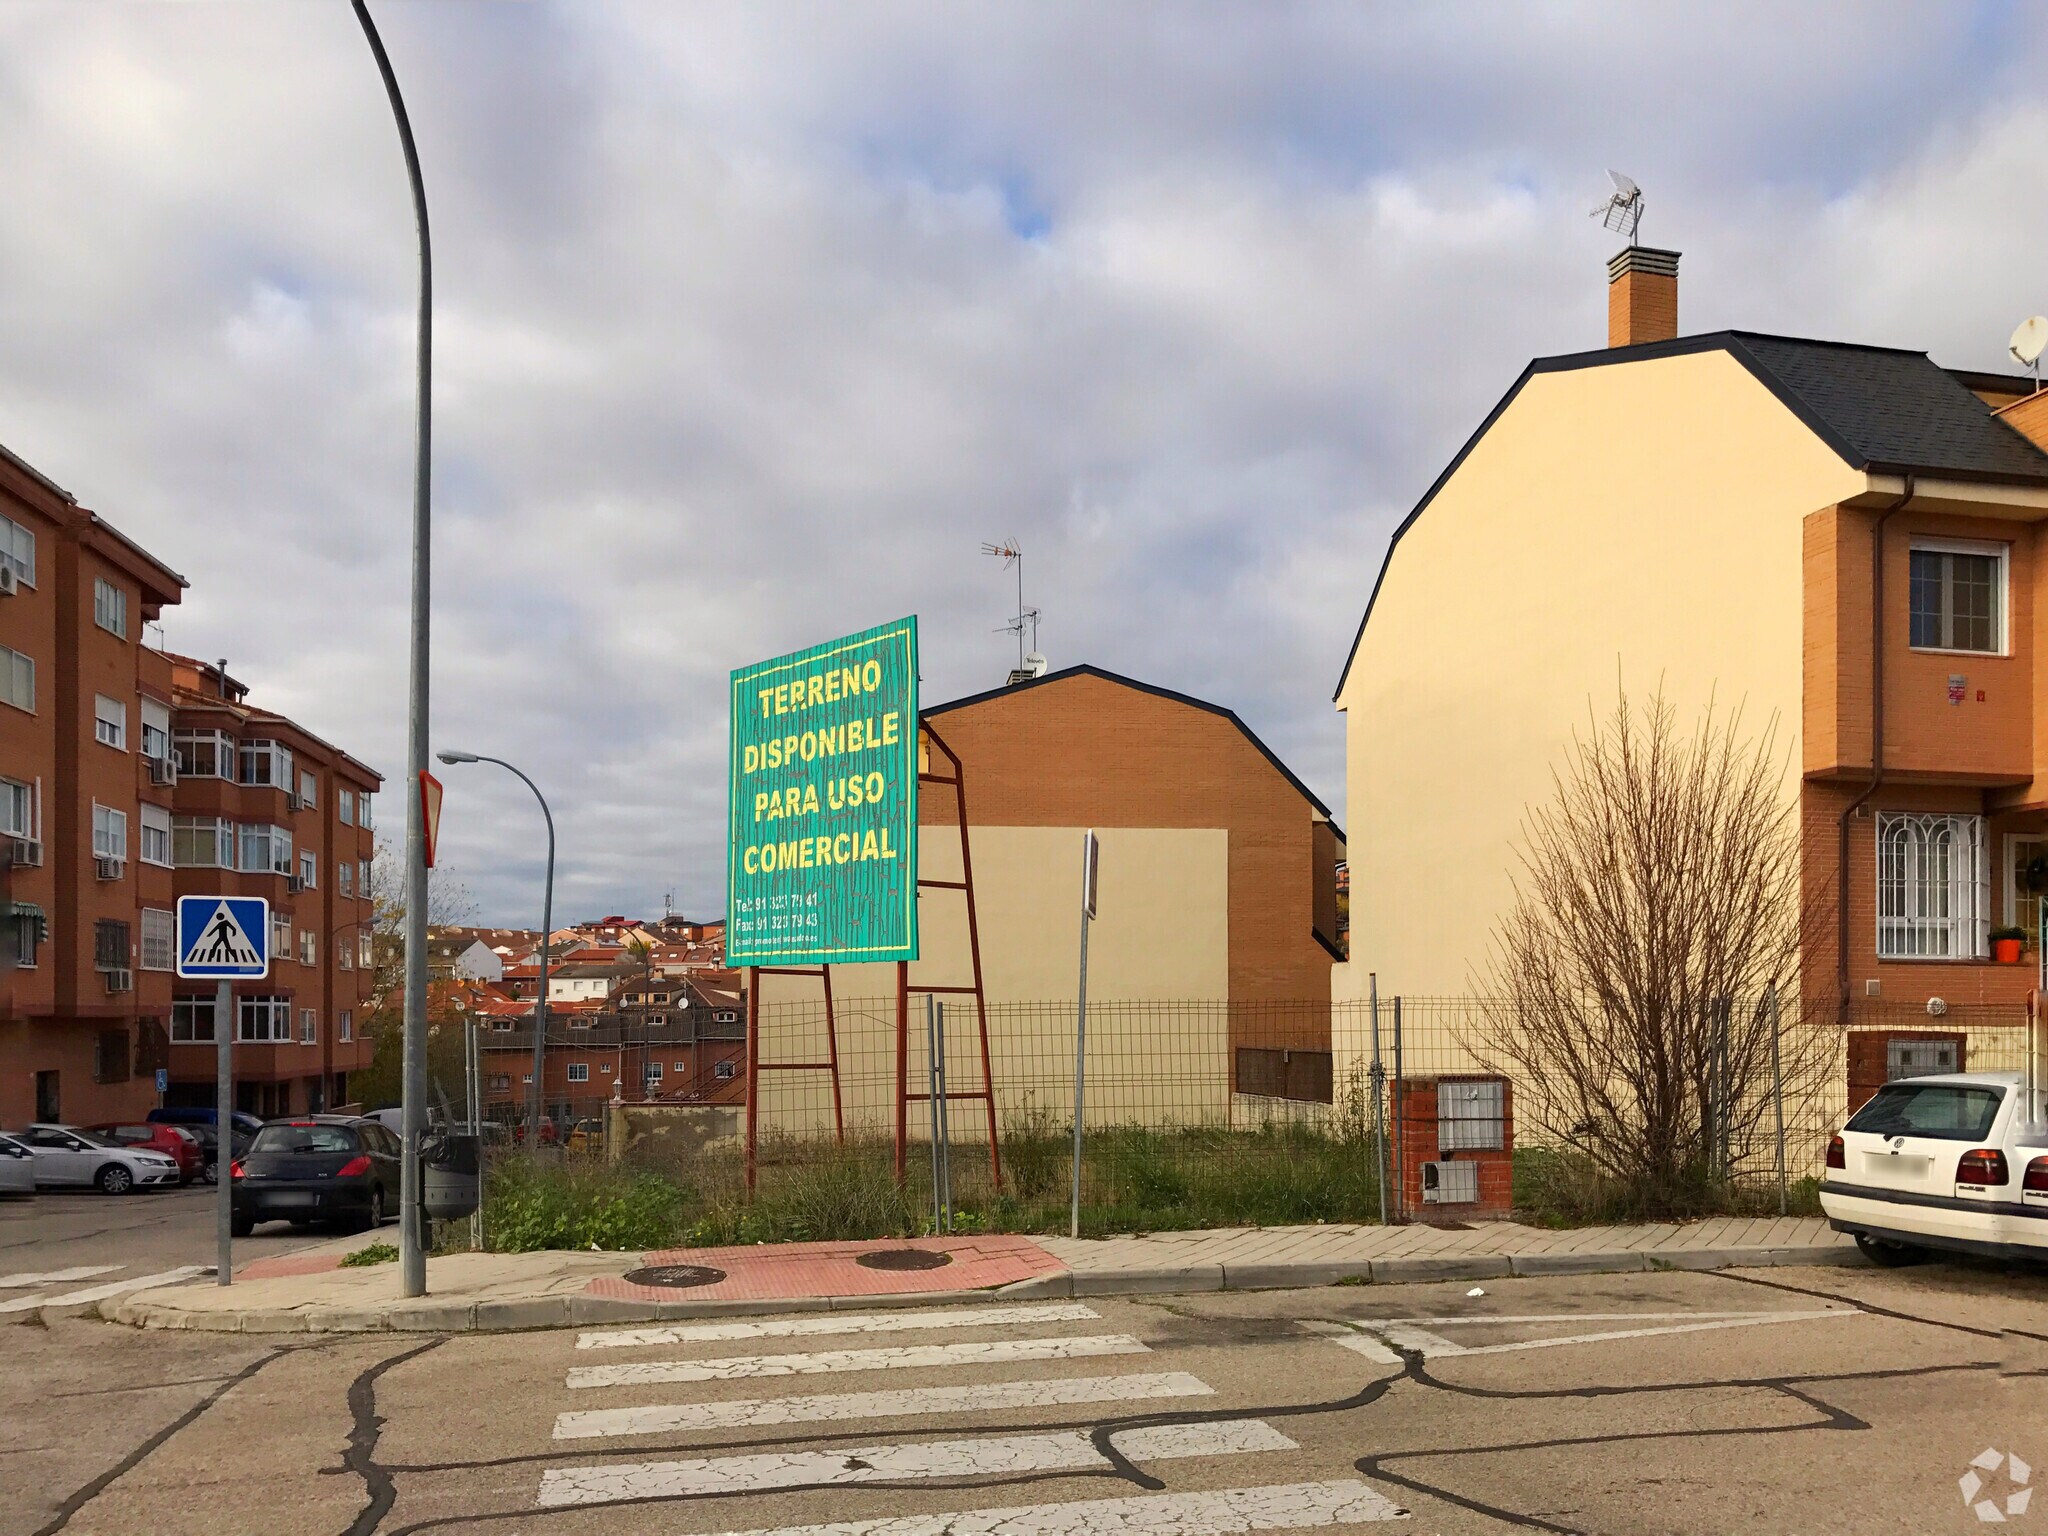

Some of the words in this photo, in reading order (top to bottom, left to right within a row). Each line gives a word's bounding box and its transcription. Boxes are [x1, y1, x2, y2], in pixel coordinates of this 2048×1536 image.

[758, 660, 881, 718] TERRENO
[744, 711, 898, 774] DISPONIBLE
[755, 784, 819, 822] PARA
[828, 771, 884, 811] USO
[744, 828, 896, 875] COMERCIAL
[736, 918, 754, 931] Fax:
[757, 916, 767, 930] 91
[771, 915, 788, 929] 323
[791, 914, 803, 927] 79
[806, 913, 818, 926] 43
[756, 897, 766, 910] 91
[806, 892, 817, 907] 41
